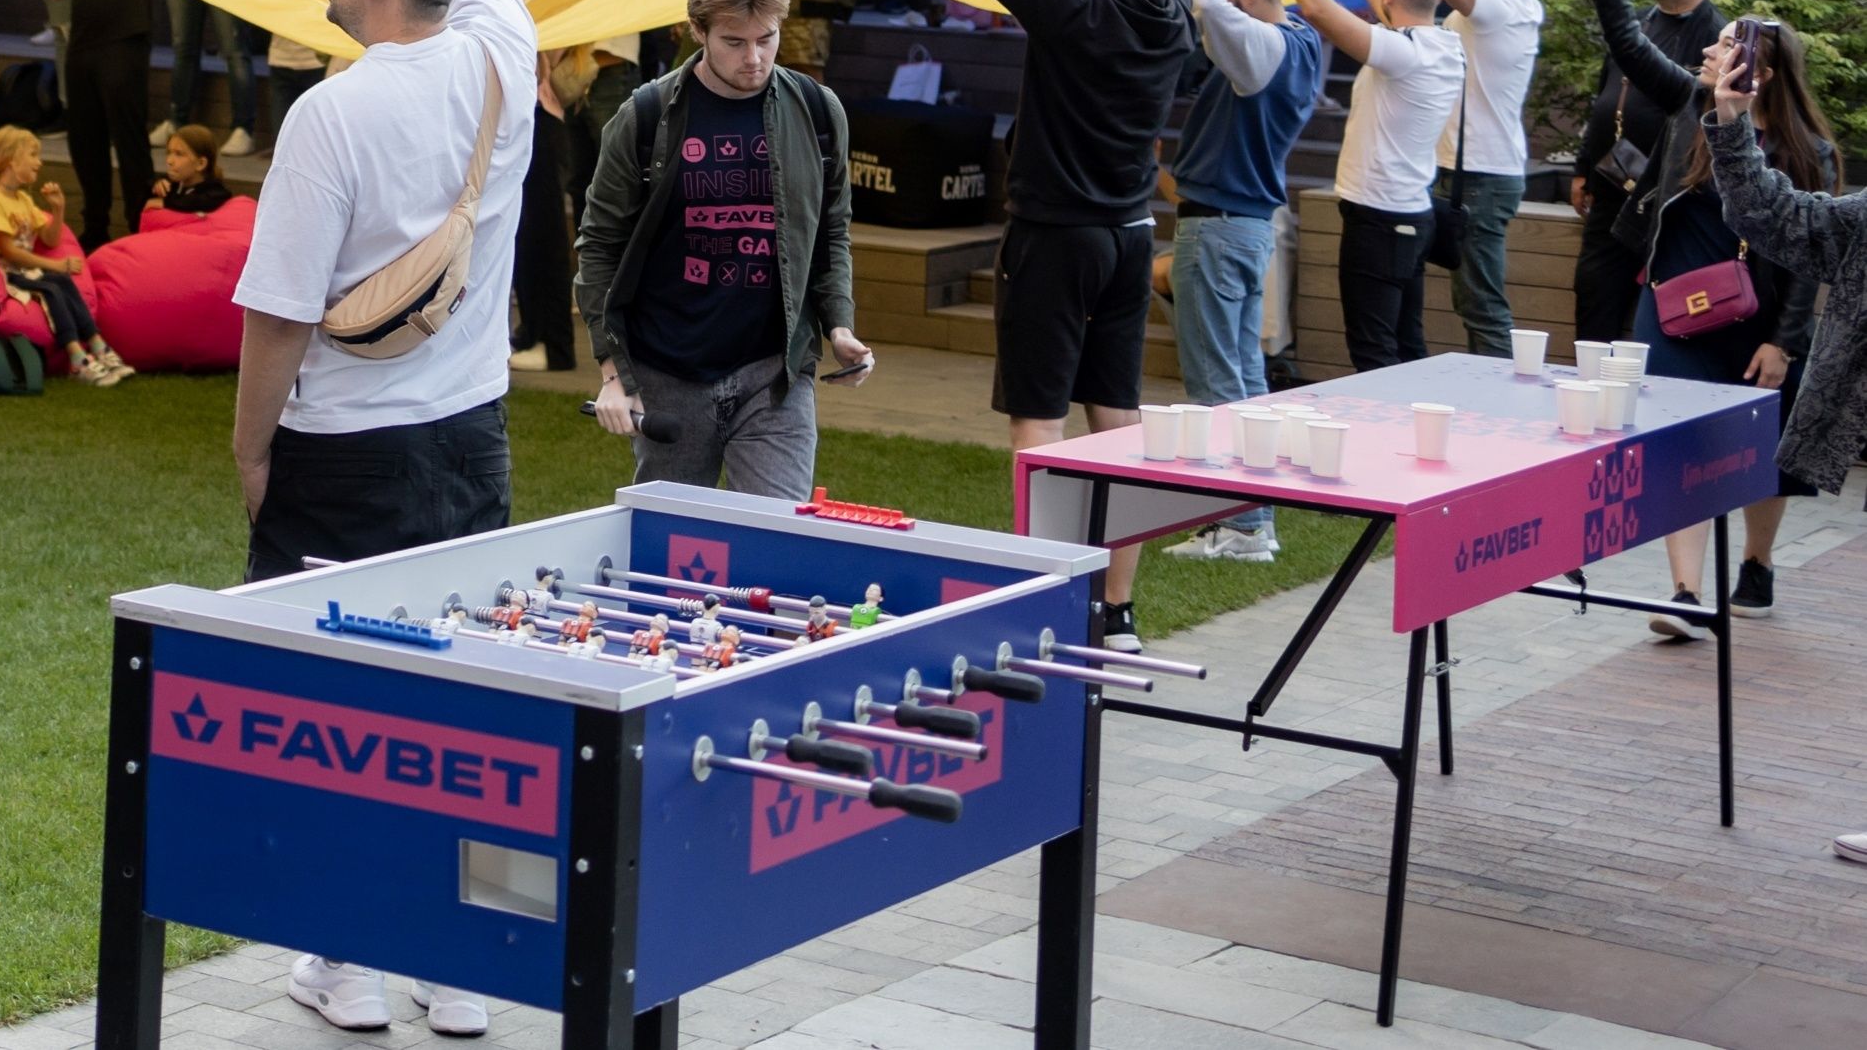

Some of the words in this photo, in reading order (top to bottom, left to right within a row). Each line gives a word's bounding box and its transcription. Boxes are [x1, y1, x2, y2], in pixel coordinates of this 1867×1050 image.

[685, 233, 734, 255] THE
[737, 236, 777, 256] GA
[1471, 517, 1543, 568] FAVBET
[239, 709, 540, 808] FAVBET
[813, 709, 995, 823] FVBE
